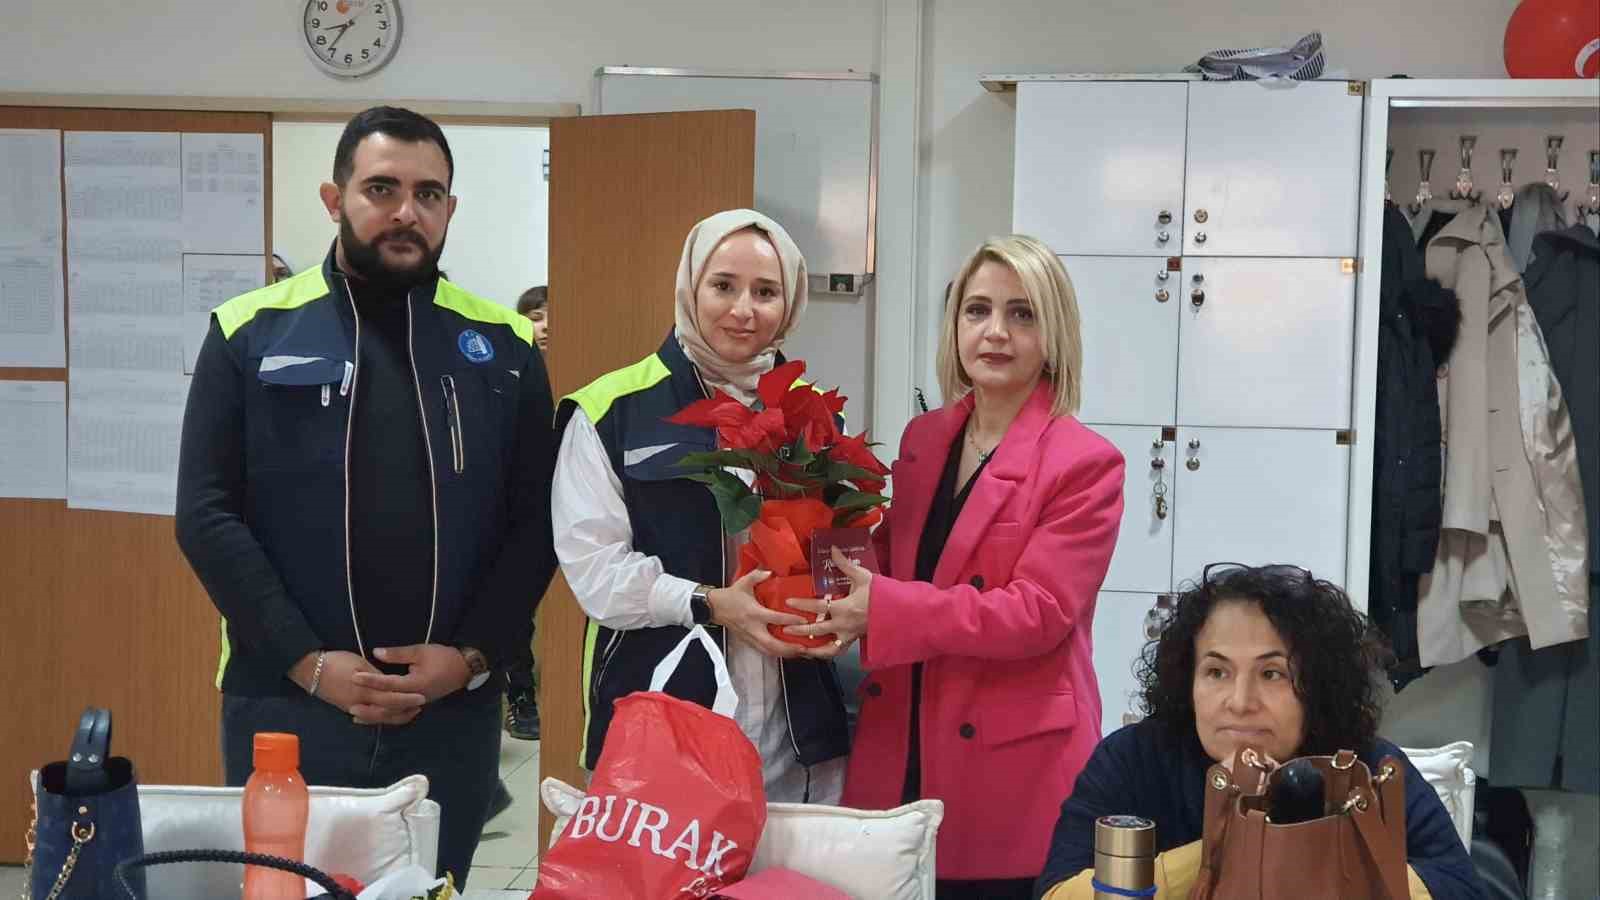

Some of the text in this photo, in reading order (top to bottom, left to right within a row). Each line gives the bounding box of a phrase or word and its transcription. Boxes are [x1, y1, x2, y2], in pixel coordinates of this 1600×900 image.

[317, 0, 328, 11] 10
[374, 4, 383, 14] 2
[311, 18, 320, 29] 9
[378, 20, 387, 30] 3
[316, 35, 327, 45] 8
[373, 37, 382, 48] 4
[327, 47, 336, 58] 7
[361, 48, 369, 59] 5
[344, 54, 353, 64] 6
[569, 795, 738, 876] BURAK
